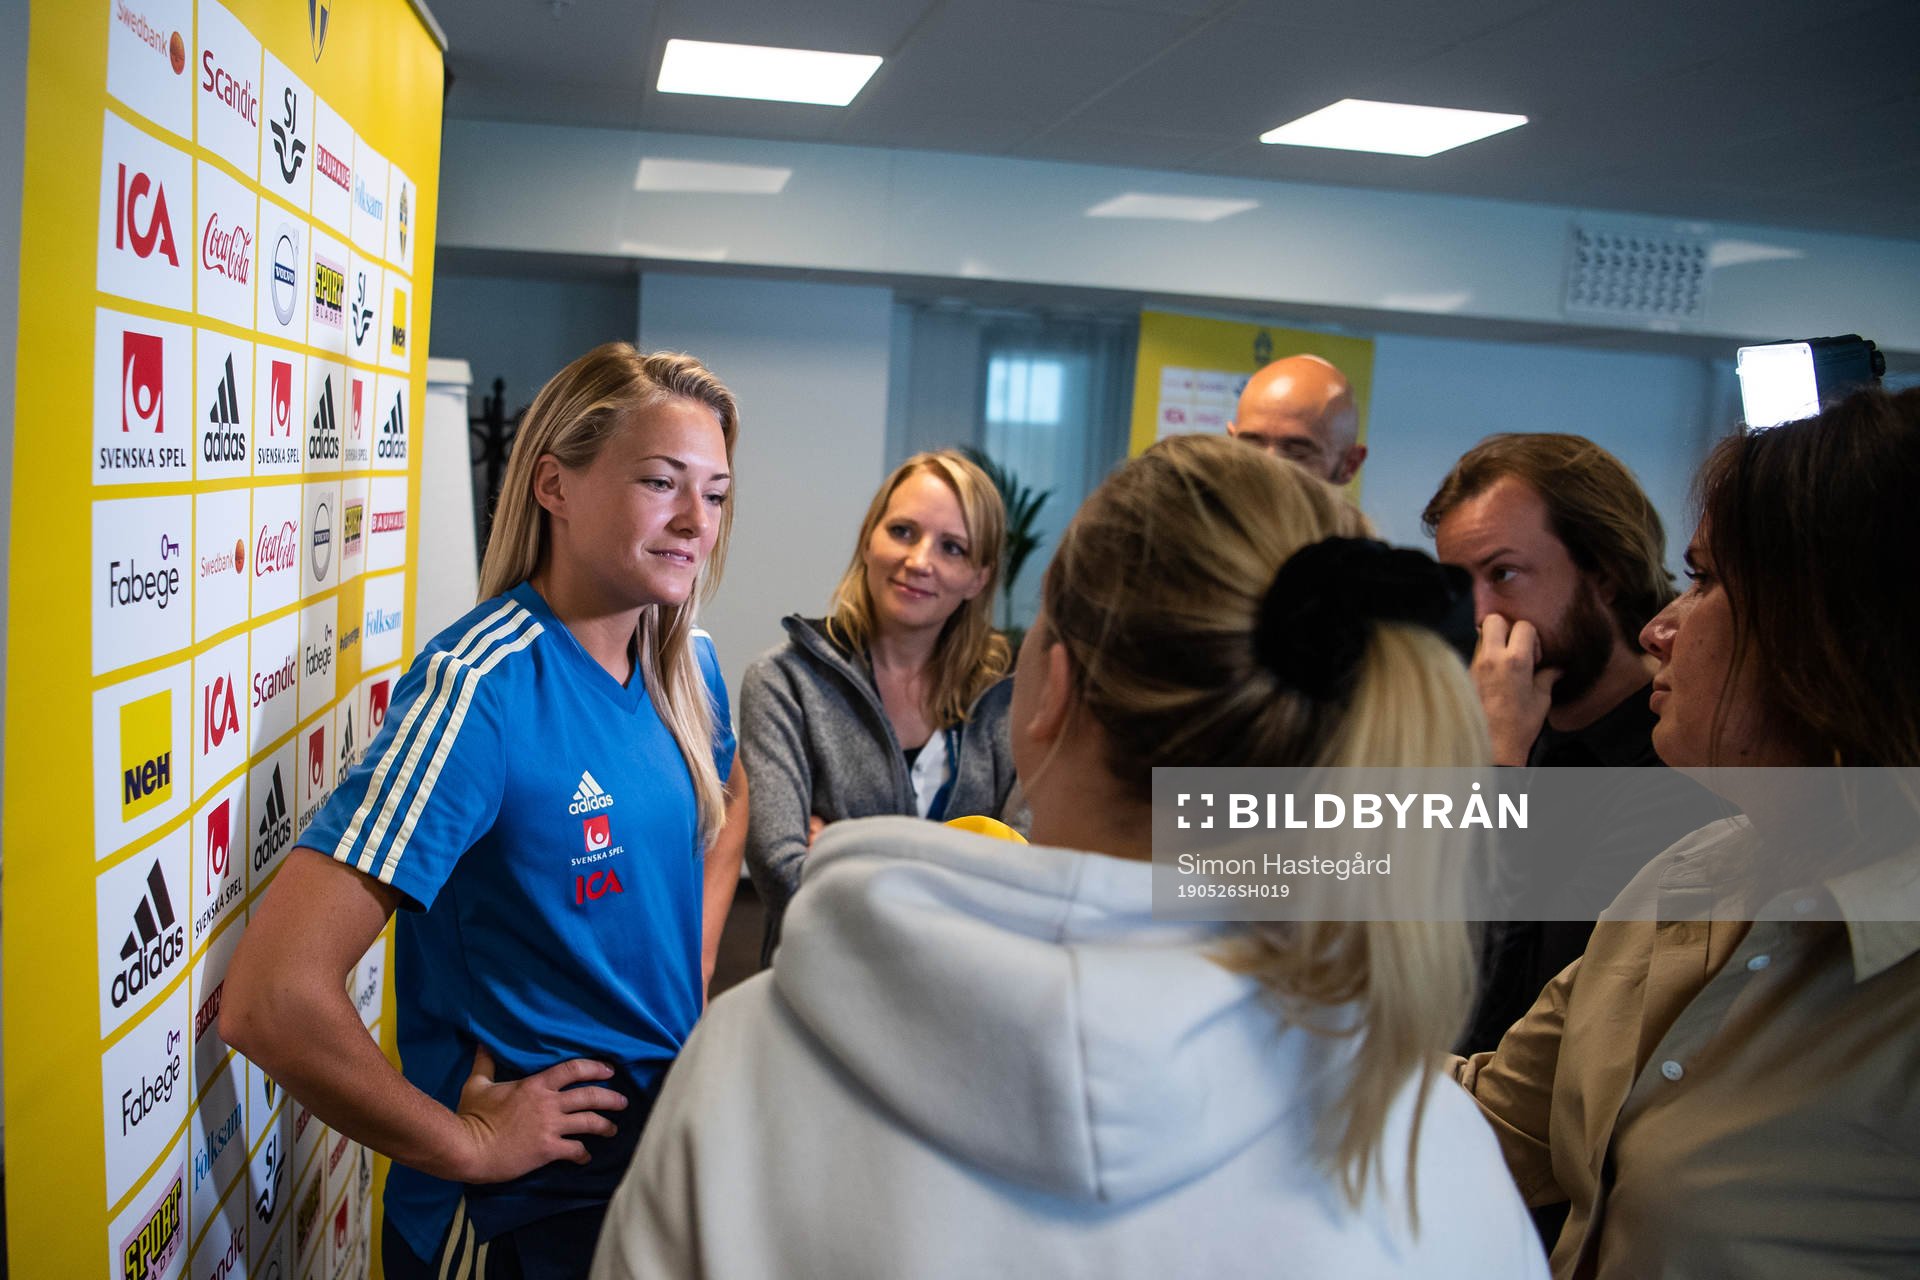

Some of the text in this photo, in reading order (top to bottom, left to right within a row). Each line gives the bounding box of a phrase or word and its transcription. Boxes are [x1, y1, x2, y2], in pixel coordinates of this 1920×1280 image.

[202, 49, 257, 127] Scandic
[284, 87, 297, 135] SJ
[316, 146, 350, 190] BAUHAUS
[116, 163, 180, 267] ICA
[275, 265, 295, 284] VOLVO
[315, 261, 344, 313] SPORT
[357, 271, 366, 308] SJ
[315, 304, 342, 324] BLADET
[100, 447, 186, 469] SVENSKA SPEL
[204, 422, 246, 462] adidas
[258, 447, 300, 464] SVENSKA SPEL
[309, 429, 339, 459] adidas
[110, 559, 179, 609] Fabege
[201, 552, 234, 578] Swedbank
[365, 608, 401, 638] Folksam
[254, 655, 296, 708] Scandic
[305, 644, 331, 678] Fabege
[204, 672, 239, 756] ICA
[568, 793, 614, 815] adidas
[254, 817, 292, 872] adidas
[571, 845, 625, 866] SVENSKA SPEL
[195, 876, 242, 940] SVENSKA SPEL
[576, 867, 624, 905] ICA
[112, 926, 184, 1008] adidas
[122, 1054, 180, 1137] Fabege
[195, 1103, 242, 1193] Folksam
[124, 1176, 181, 1280] SPORT
